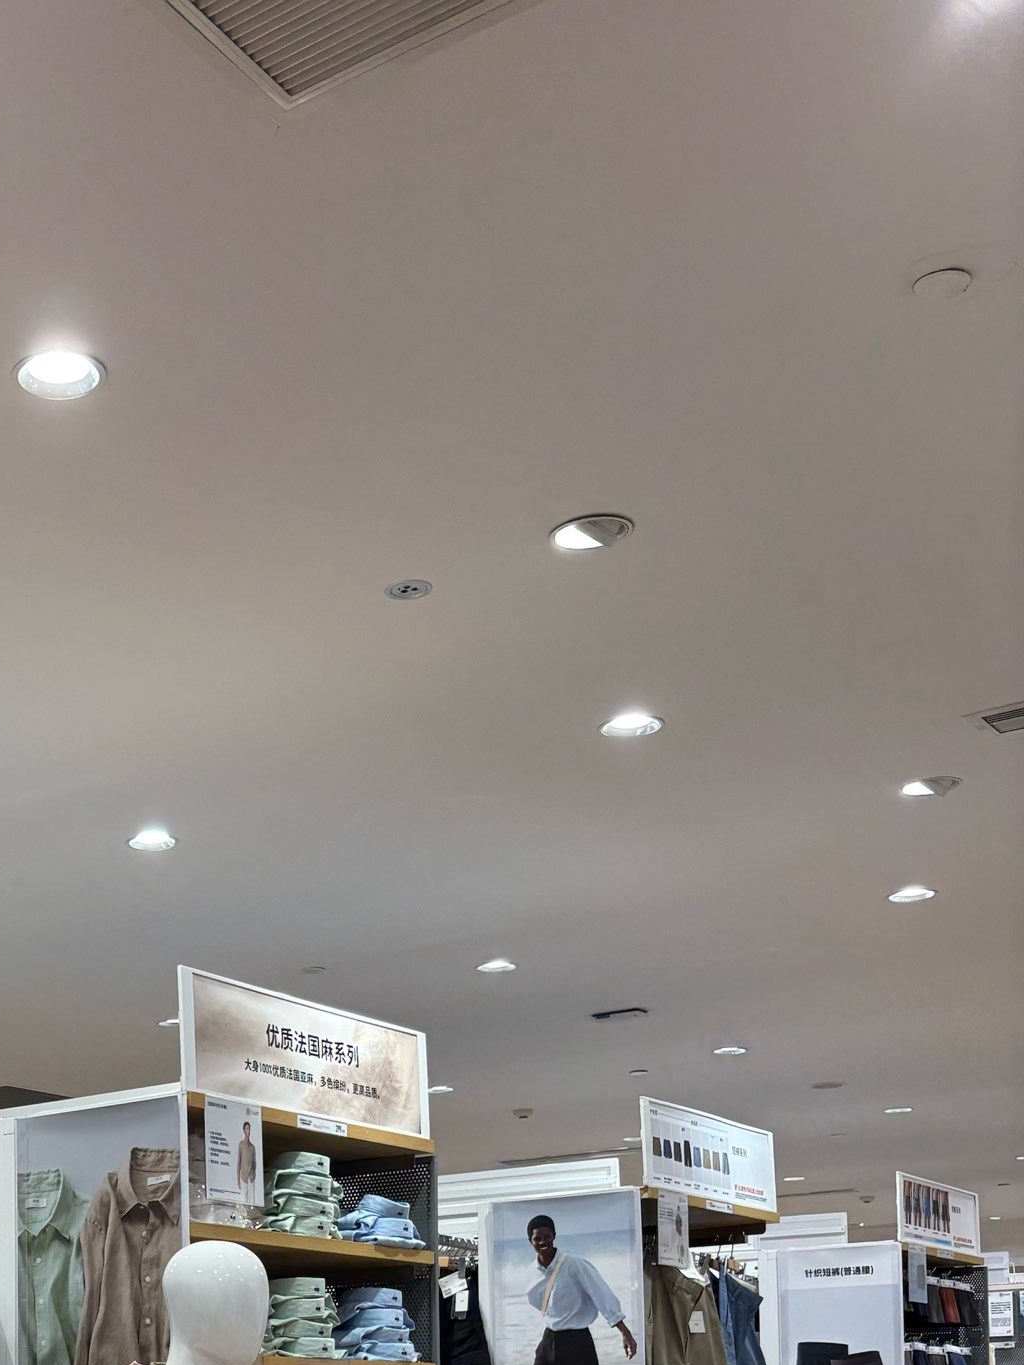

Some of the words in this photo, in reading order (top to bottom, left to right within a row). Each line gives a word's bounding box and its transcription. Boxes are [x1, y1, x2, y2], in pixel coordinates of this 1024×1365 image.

[265, 1023, 360, 1068] 优质法国麻系列
[244, 1058, 381, 1100] 大身100%优质法国亚麻，多色缤纷，更高品质。
[804, 1265, 874, 1278] 针织短裤(普通腰)
